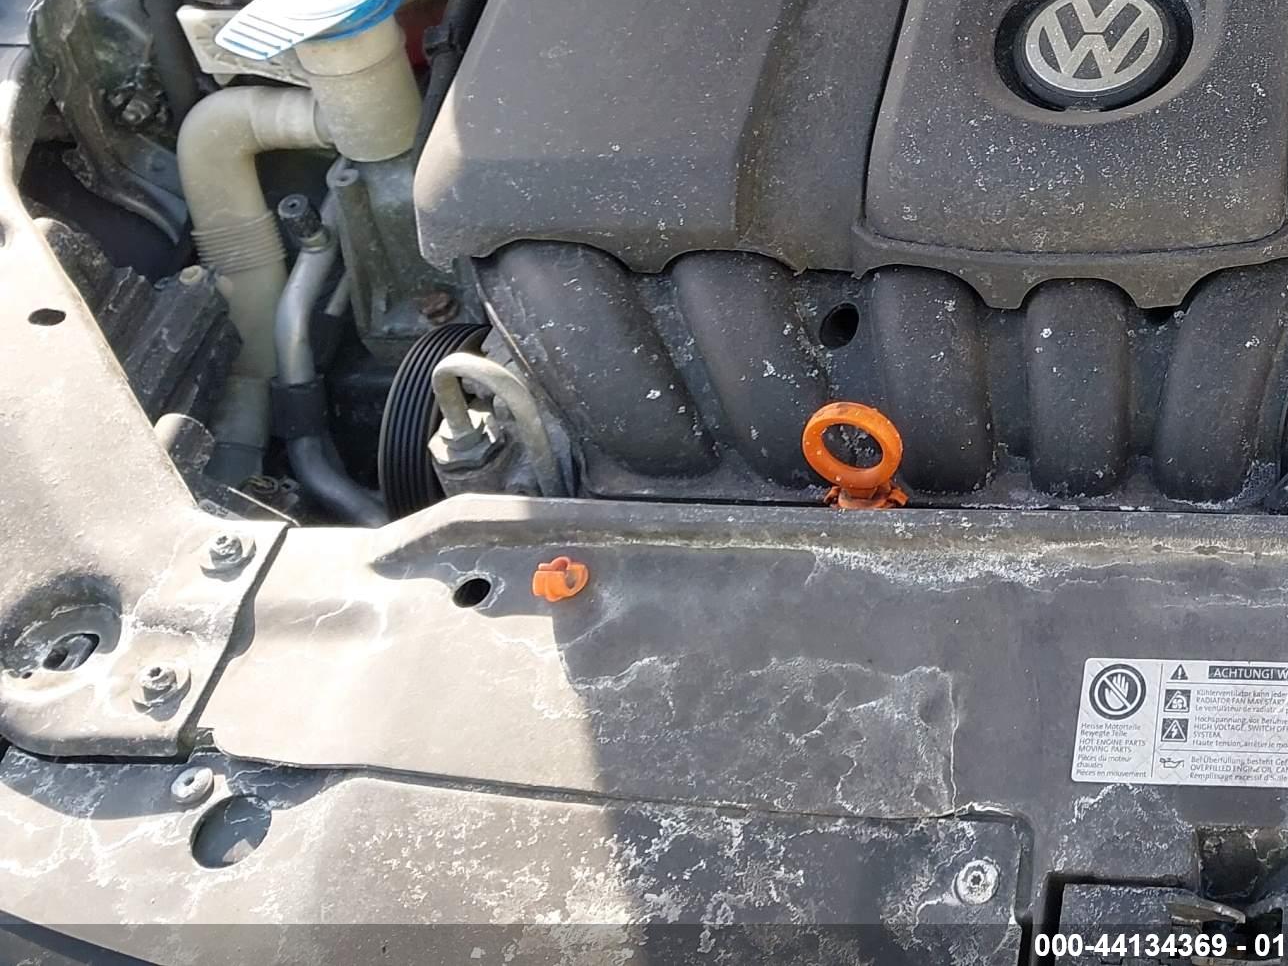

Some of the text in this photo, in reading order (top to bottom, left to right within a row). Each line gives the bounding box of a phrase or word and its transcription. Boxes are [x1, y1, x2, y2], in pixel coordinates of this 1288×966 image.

[1213, 667, 1274, 679] ACHTUNG!
[1265, 698, 1285, 706] START
[1081, 722, 1141, 730] Heisse Motorteile
[1080, 730, 1110, 738] Bewegte
[1080, 737, 1094, 745] HOT
[1096, 738, 1122, 746] ENGINE
[1098, 754, 1106, 762] du
[1190, 764, 1232, 772] OVERFILLED
[1190, 772, 1232, 782] Remplissage
